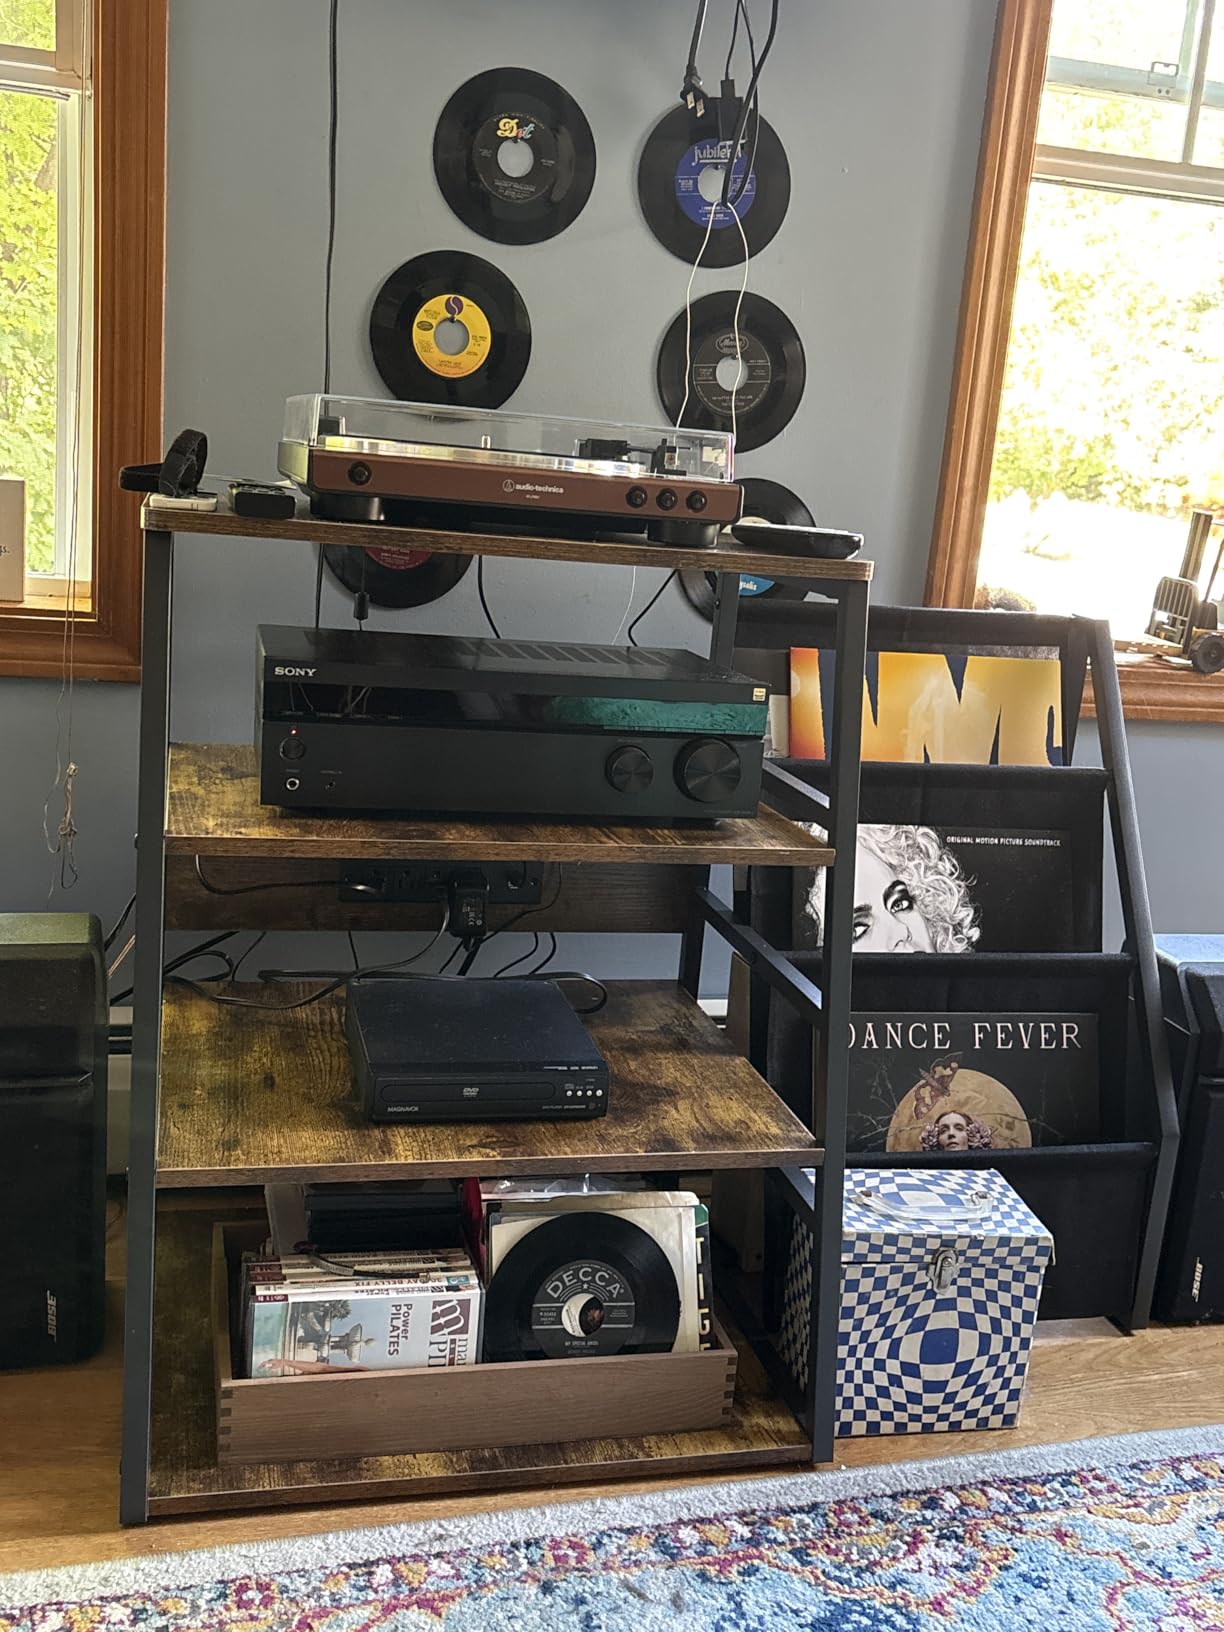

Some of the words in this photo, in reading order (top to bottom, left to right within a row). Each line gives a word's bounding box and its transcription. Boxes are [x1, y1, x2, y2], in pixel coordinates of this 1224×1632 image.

[515, 483, 565, 494] audio-technica
[274, 666, 318, 678] SONY
[946, 836, 974, 844] ORIGINAL
[975, 837, 999, 845] MOTION
[1000, 838, 1023, 846] PICTURE
[1024, 838, 1061, 847] SOUNDTRACK
[972, 1022, 1082, 1049] FEVER
[546, 1267, 621, 1298] DECCA
[696, 1236, 711, 1351] TIG
[1192, 1256, 1203, 1302] BOSE
[47, 1290, 57, 1342] BOSE
[388, 1304, 402, 1356] PILATES
[401, 1303, 413, 1340] Power
